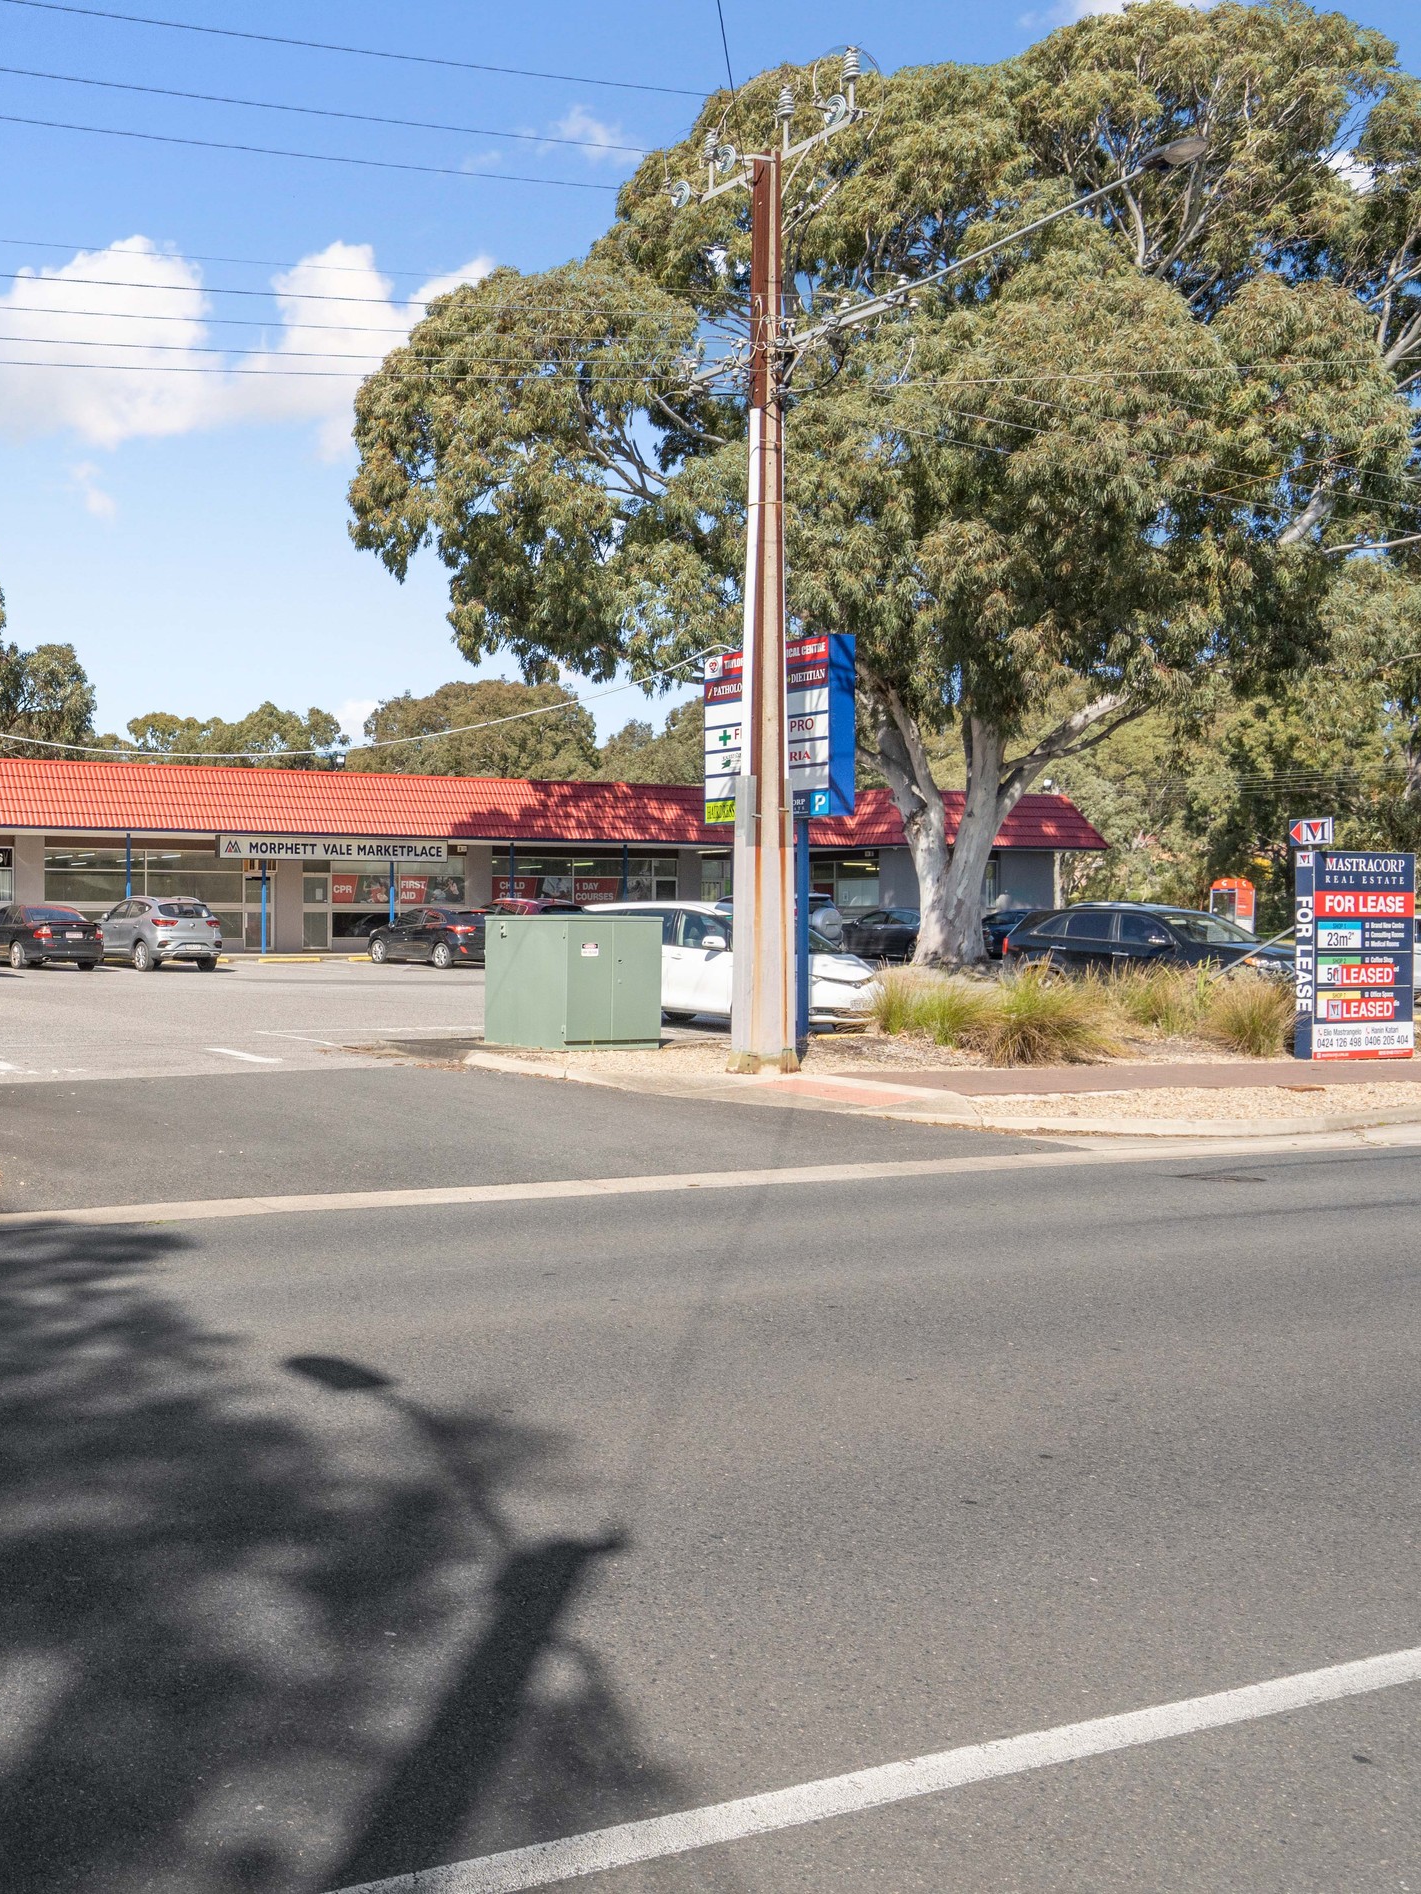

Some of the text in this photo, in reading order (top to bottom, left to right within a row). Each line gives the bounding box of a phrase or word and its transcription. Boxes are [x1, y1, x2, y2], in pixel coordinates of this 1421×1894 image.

[786, 642, 825, 658] ICAL CENTRE
[791, 669, 825, 683] DIETITIAN
[713, 683, 742, 696] PATHOLO
[790, 718, 815, 732] PRO
[789, 751, 811, 761] RIA
[815, 794, 826, 811] P
[1304, 822, 1328, 841] M
[248, 842, 442, 858] MORPHETT VALE MARKETPLACE
[1325, 857, 1405, 872] MASTRACORP
[401, 880, 426, 890] FIRST
[500, 881, 525, 889] CHLD
[1325, 875, 1405, 885] REAL ESTATE
[333, 885, 353, 894] CPR
[400, 892, 416, 900] AID
[576, 892, 614, 901] COURSES
[1325, 895, 1405, 913] FOR LEASE
[1296, 896, 1313, 1012] FOR LEASE
[1343, 967, 1393, 983] LEASED
[1343, 1002, 1393, 1018] LEASED
[1317, 1037, 1362, 1048] 0424 126 498
[1365, 1035, 1408, 1046] 0406 205 404
